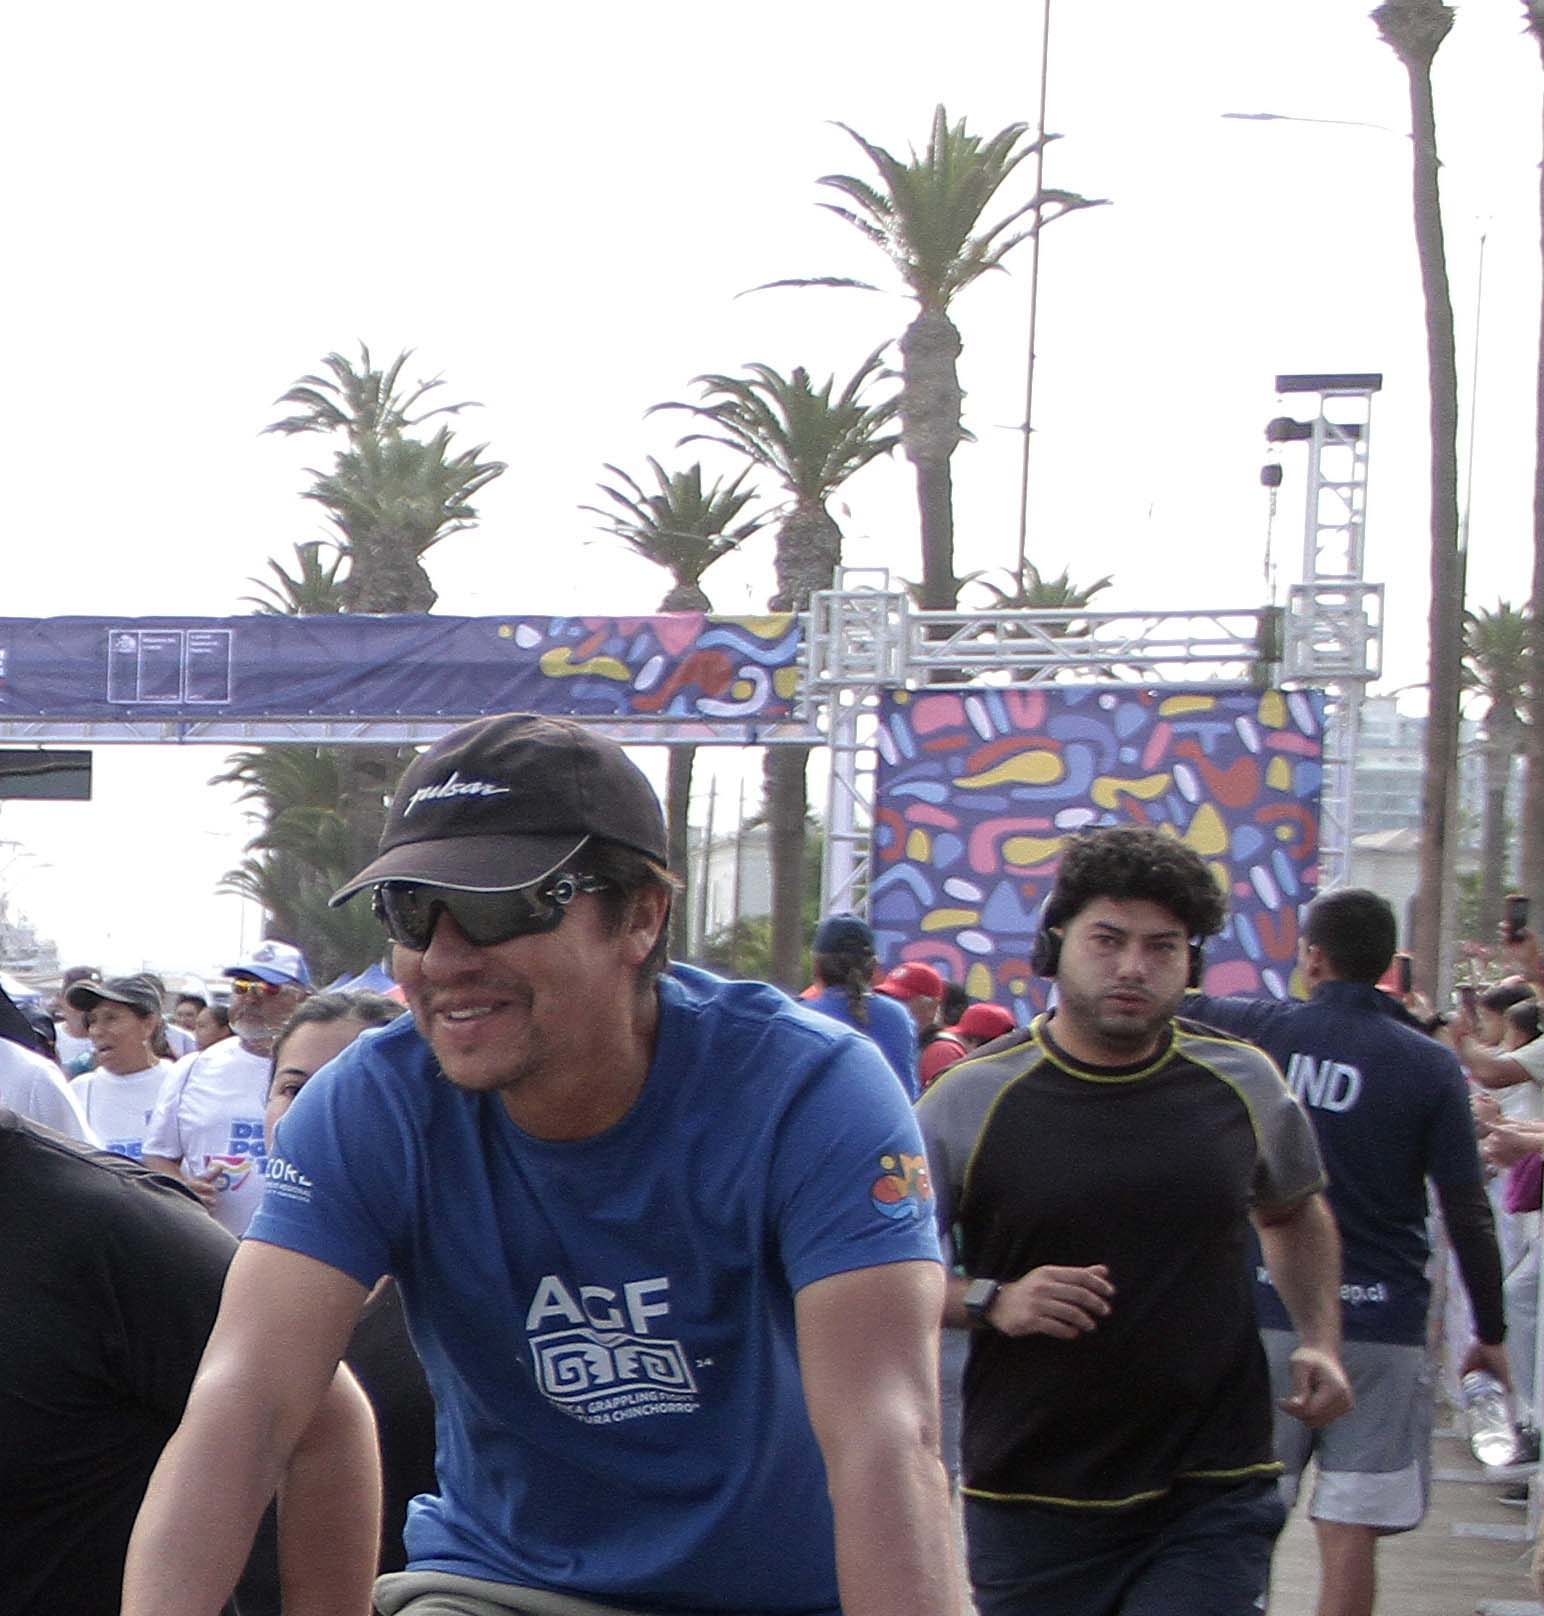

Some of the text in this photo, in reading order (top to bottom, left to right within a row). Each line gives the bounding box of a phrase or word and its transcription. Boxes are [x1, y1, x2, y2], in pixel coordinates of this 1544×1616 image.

[1286, 1052, 1363, 1113] IND
[526, 1275, 670, 1334] AGF
[587, 1391, 658, 1413] GRAPPLING
